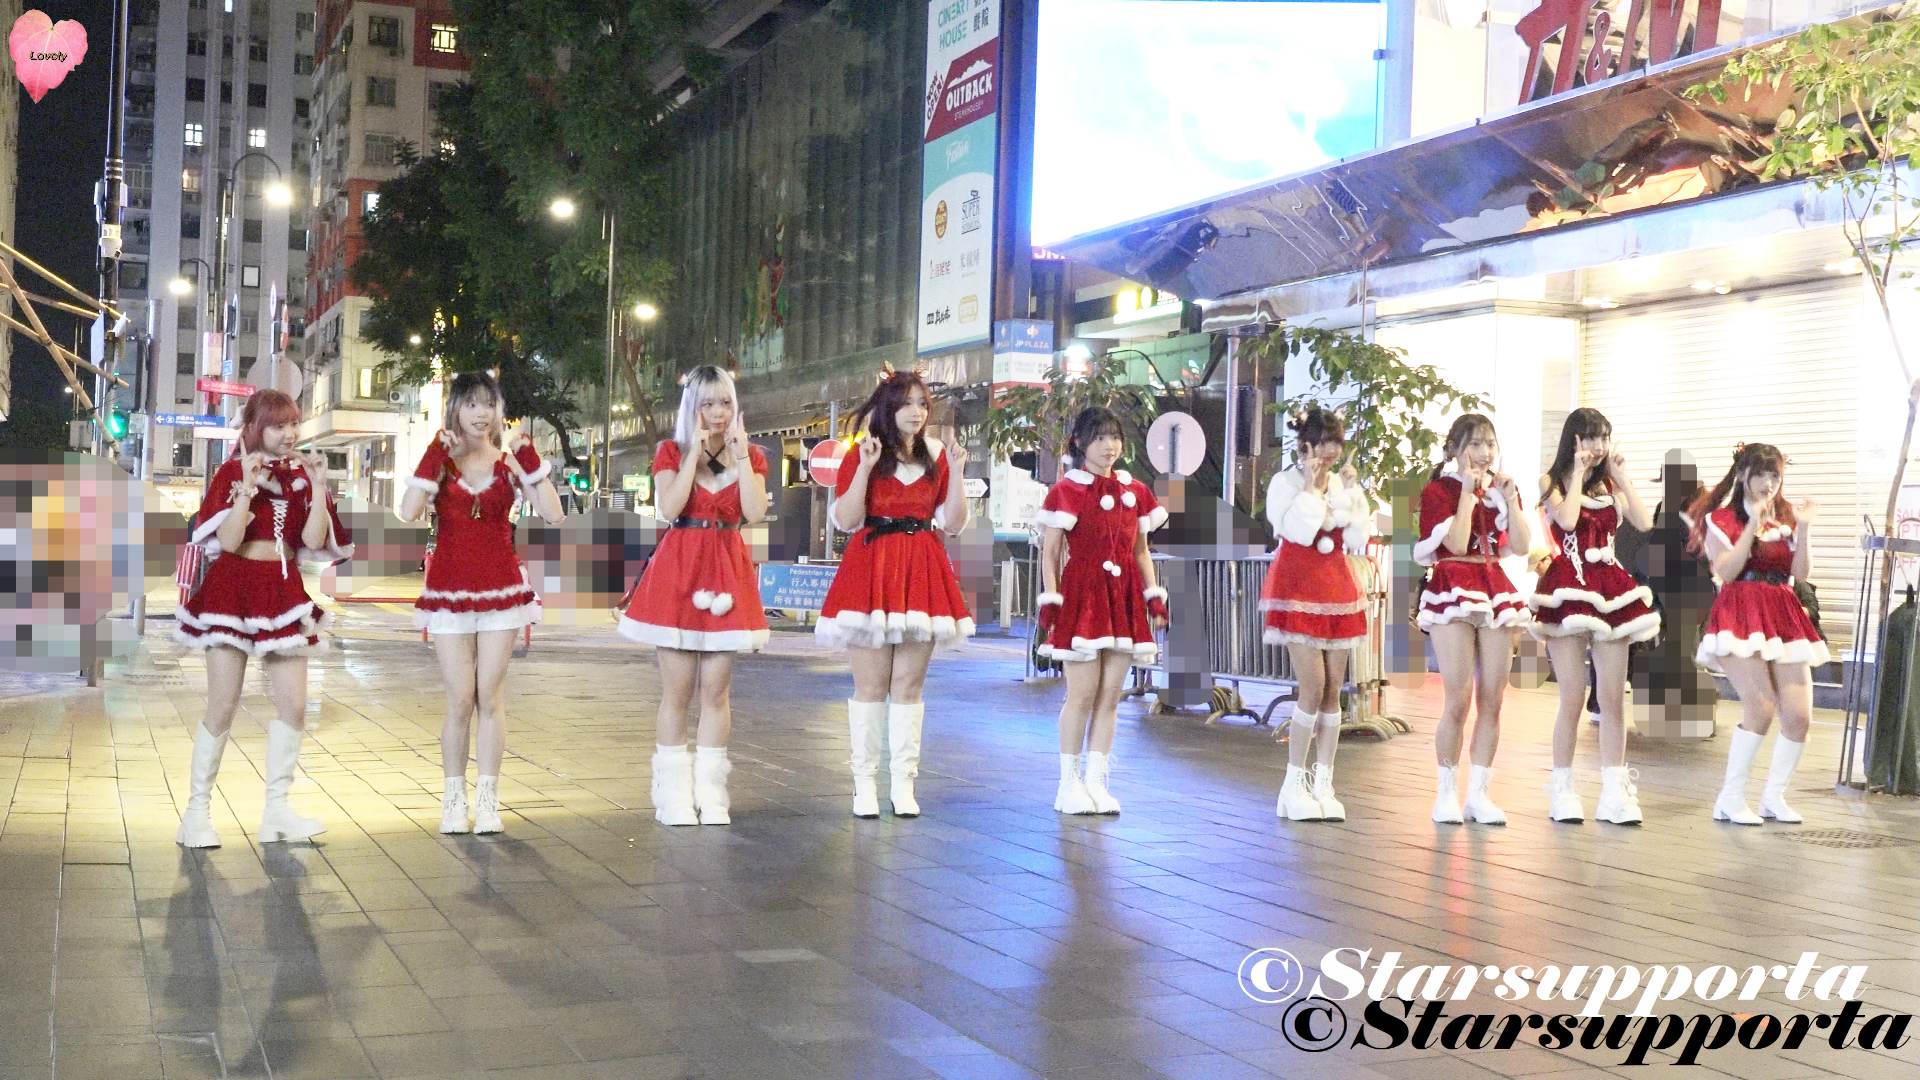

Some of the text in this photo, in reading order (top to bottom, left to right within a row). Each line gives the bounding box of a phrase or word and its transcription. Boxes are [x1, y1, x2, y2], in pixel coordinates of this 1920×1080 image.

[939, 20, 968, 49] HOUSE
[946, 71, 993, 112] OUTBACK
[1024, 341, 1050, 350] PLAZA
[789, 567, 823, 576] Pedestrian
[788, 588, 816, 596] Vehicles
